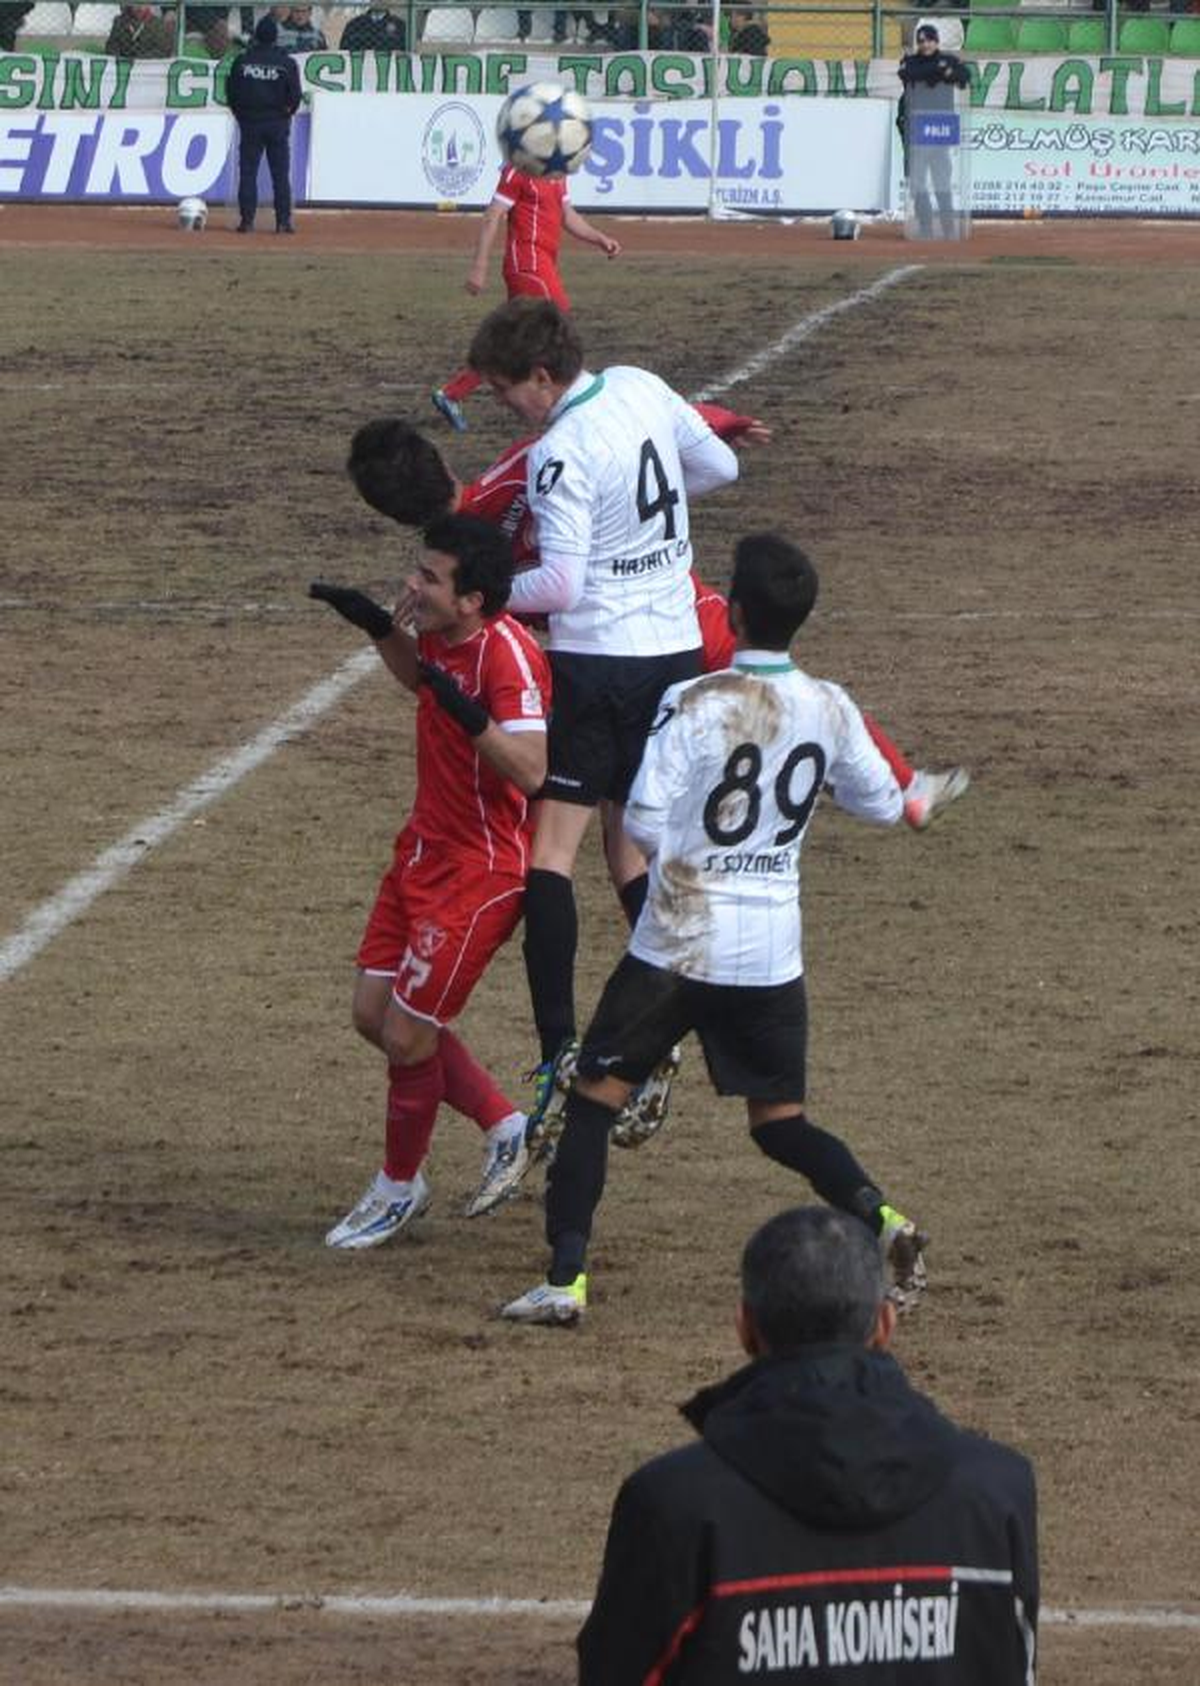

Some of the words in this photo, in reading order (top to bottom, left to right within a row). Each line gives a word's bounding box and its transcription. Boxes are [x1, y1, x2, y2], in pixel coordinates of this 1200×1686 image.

[637, 437, 679, 541] 4
[703, 741, 826, 847] 89
[738, 1605, 820, 1673] SAHA
[826, 1580, 960, 1666] KOMİSERİ
